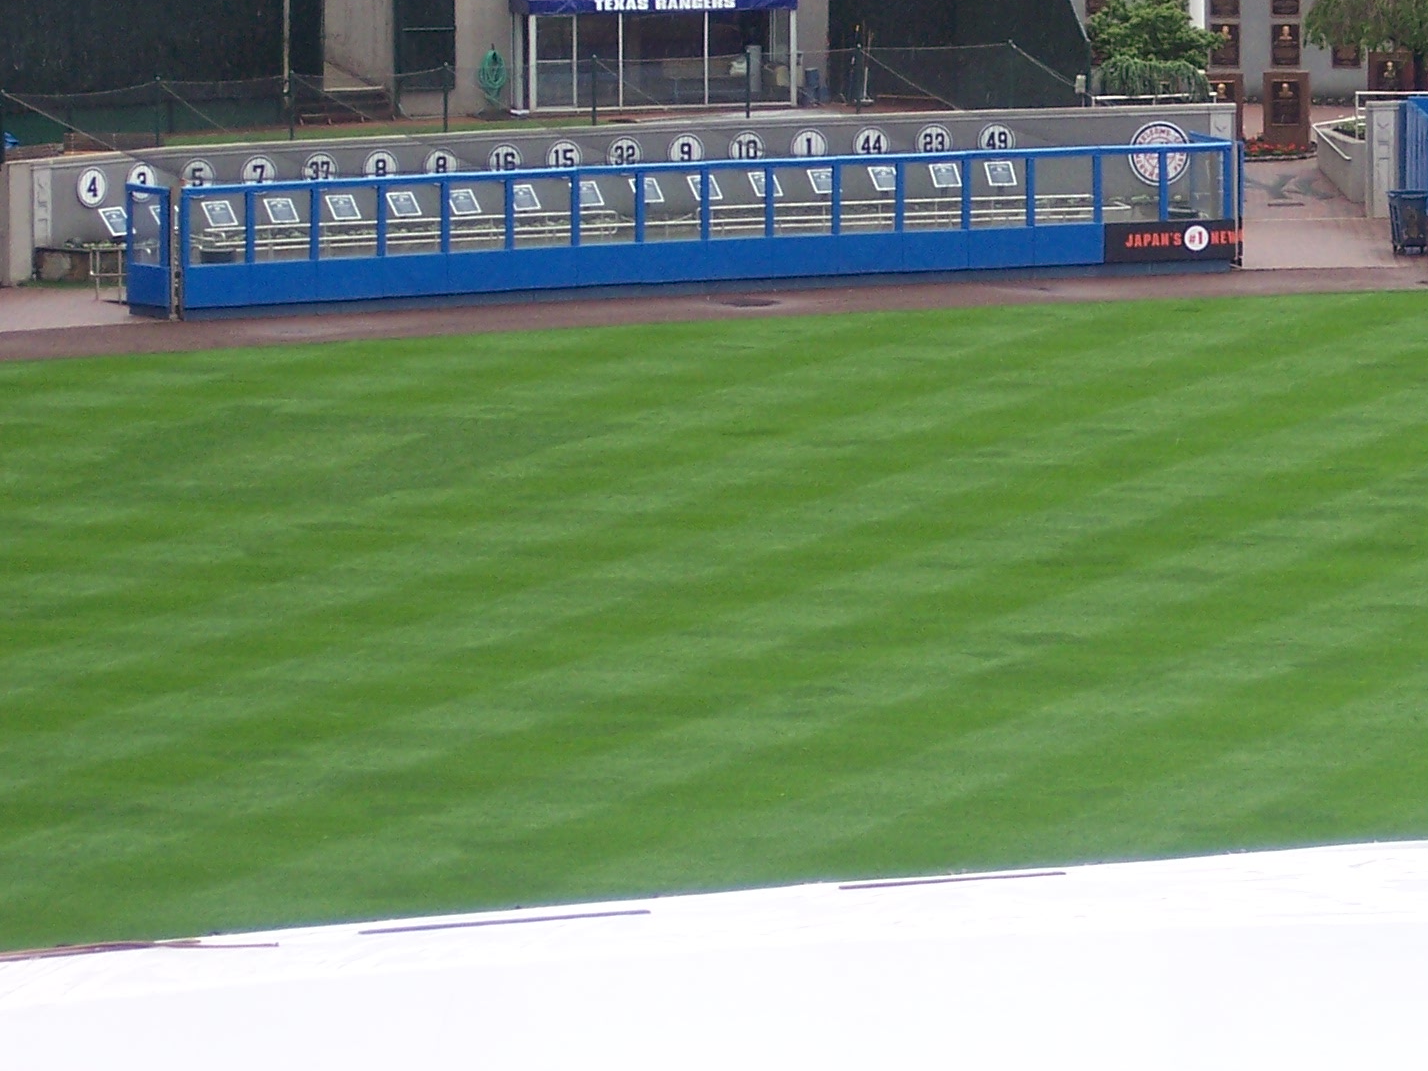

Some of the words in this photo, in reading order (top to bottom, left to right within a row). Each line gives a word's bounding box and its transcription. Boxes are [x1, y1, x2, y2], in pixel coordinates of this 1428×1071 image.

[736, 140, 758, 160] 10
[805, 137, 812, 155] 1
[861, 135, 882, 154] 44
[923, 133, 945, 152] 23
[986, 131, 1007, 151] 49
[494, 152, 515, 171] 16
[554, 149, 575, 167] 15
[615, 146, 636, 166] 32
[680, 143, 691, 161] 9
[253, 164, 265, 183] 7
[310, 161, 330, 180] 37
[375, 159, 387, 177] 8
[436, 156, 447, 174] 8
[87, 176, 98, 197] 4
[192, 168, 204, 187] 5
[1125, 231, 1182, 247] JAPAN'S
